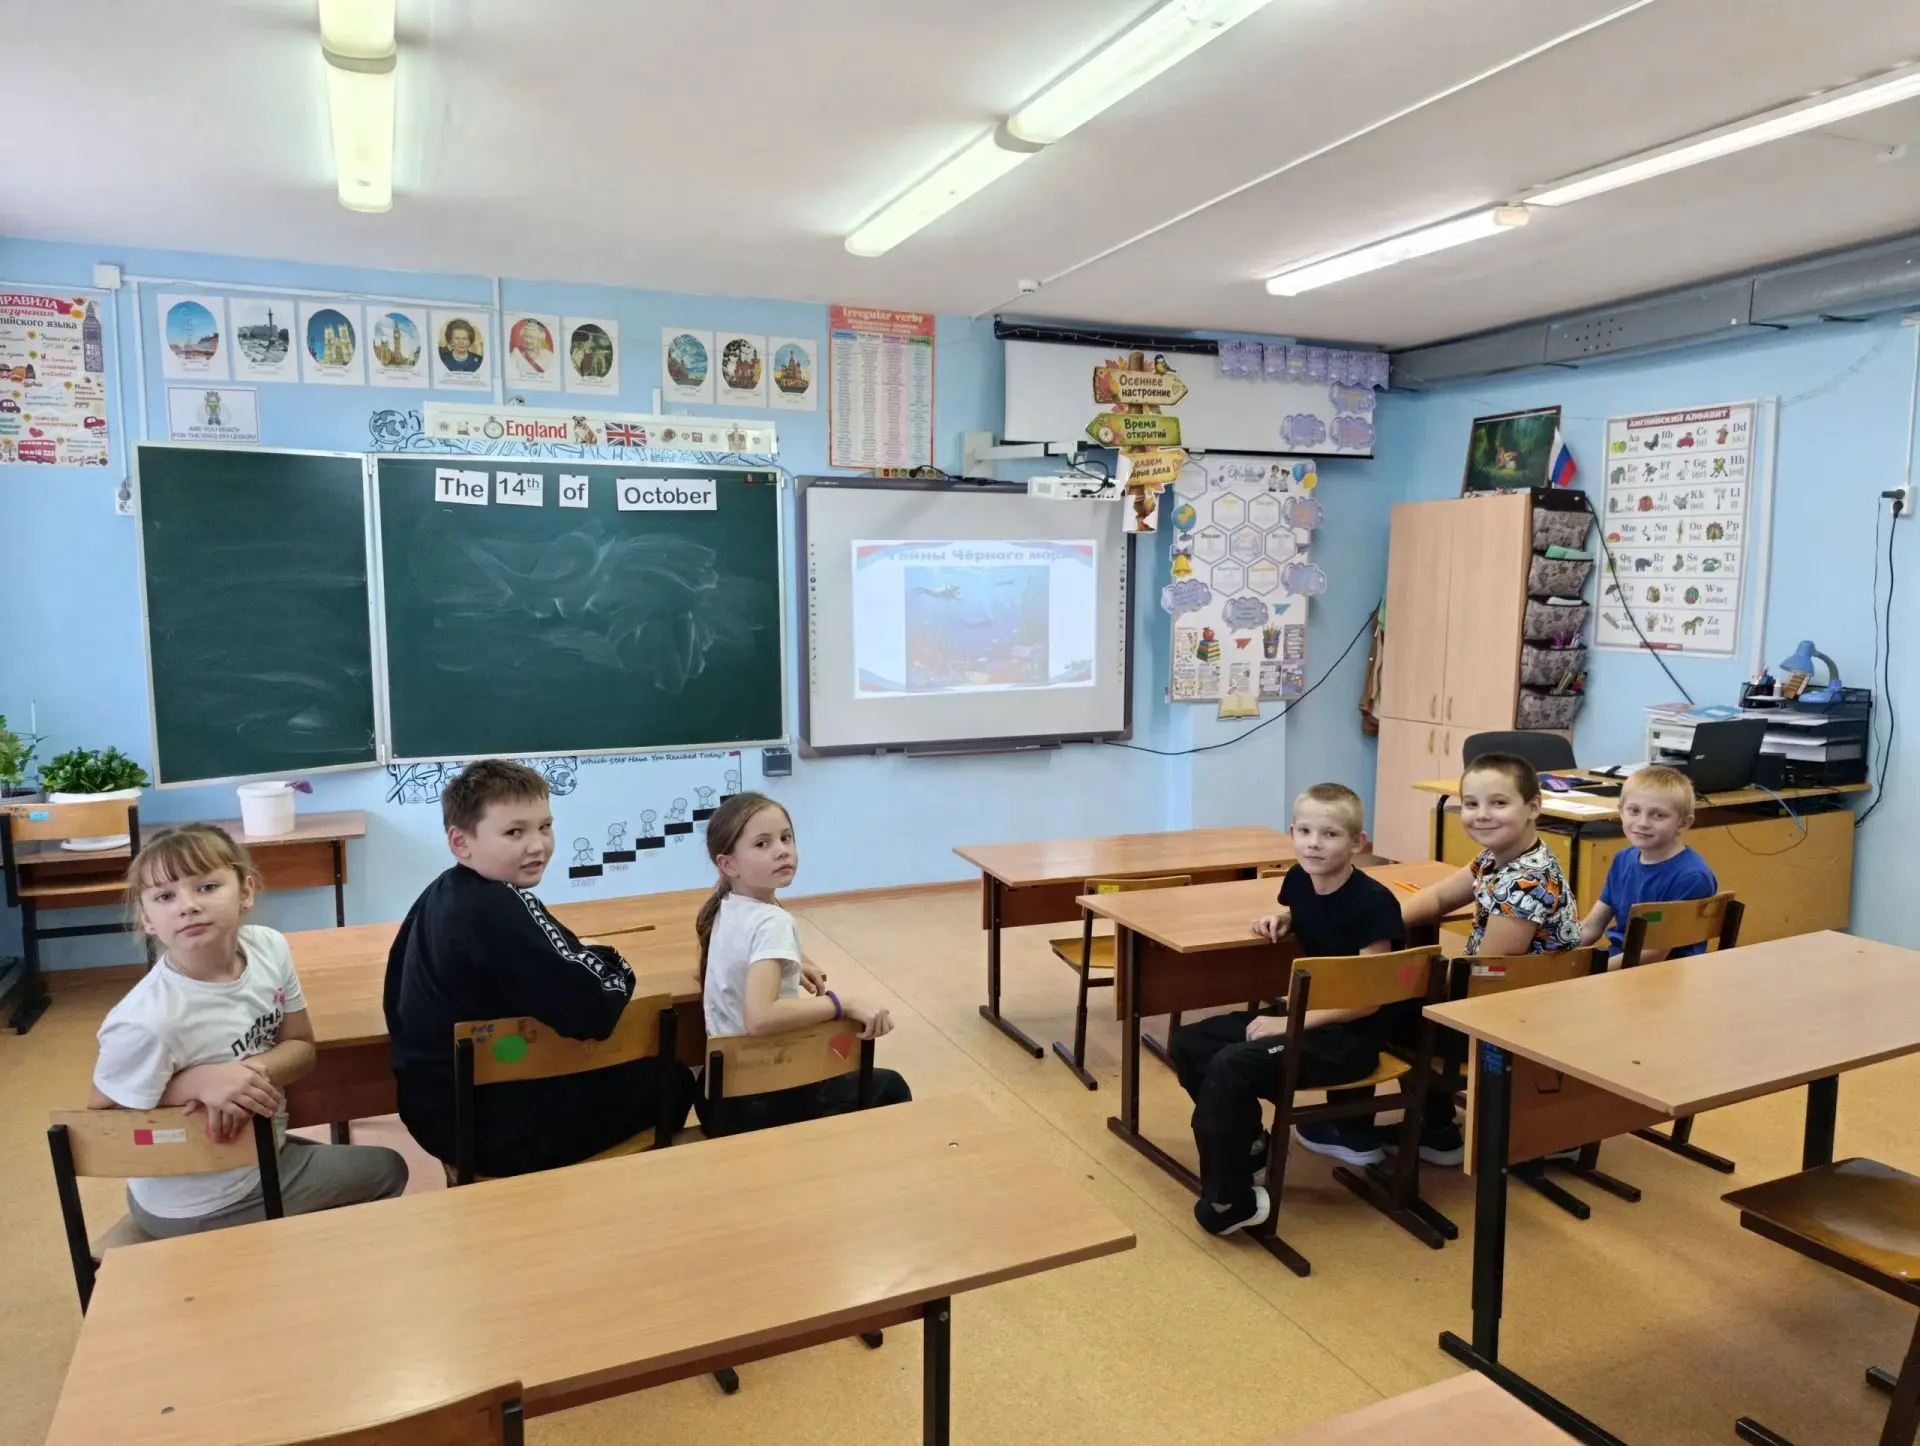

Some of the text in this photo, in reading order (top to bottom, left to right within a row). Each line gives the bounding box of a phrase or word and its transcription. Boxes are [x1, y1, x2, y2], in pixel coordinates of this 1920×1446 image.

[842, 307, 891, 320] Irregular
[46, 320, 77, 329] языка
[1119, 374, 1163, 387] Осеннее
[1121, 386, 1171, 398] настроение
[1124, 418, 1157, 430] Время
[1732, 422, 1746, 433] Dd
[506, 420, 567, 442] England
[1126, 429, 1167, 439] открытий
[1132, 458, 1163, 470] елаем
[1730, 455, 1745, 466] Hh
[439, 477, 712, 505] The 14th of October
[1690, 489, 1705, 500] Kk
[1621, 523, 1637, 532] Mm
[1655, 522, 1668, 532] Nn
[1726, 520, 1739, 531] Pp
[952, 548, 1024, 562] Чёрного
[1706, 615, 1719, 625] Zz
[666, 752, 697, 760] Reached
